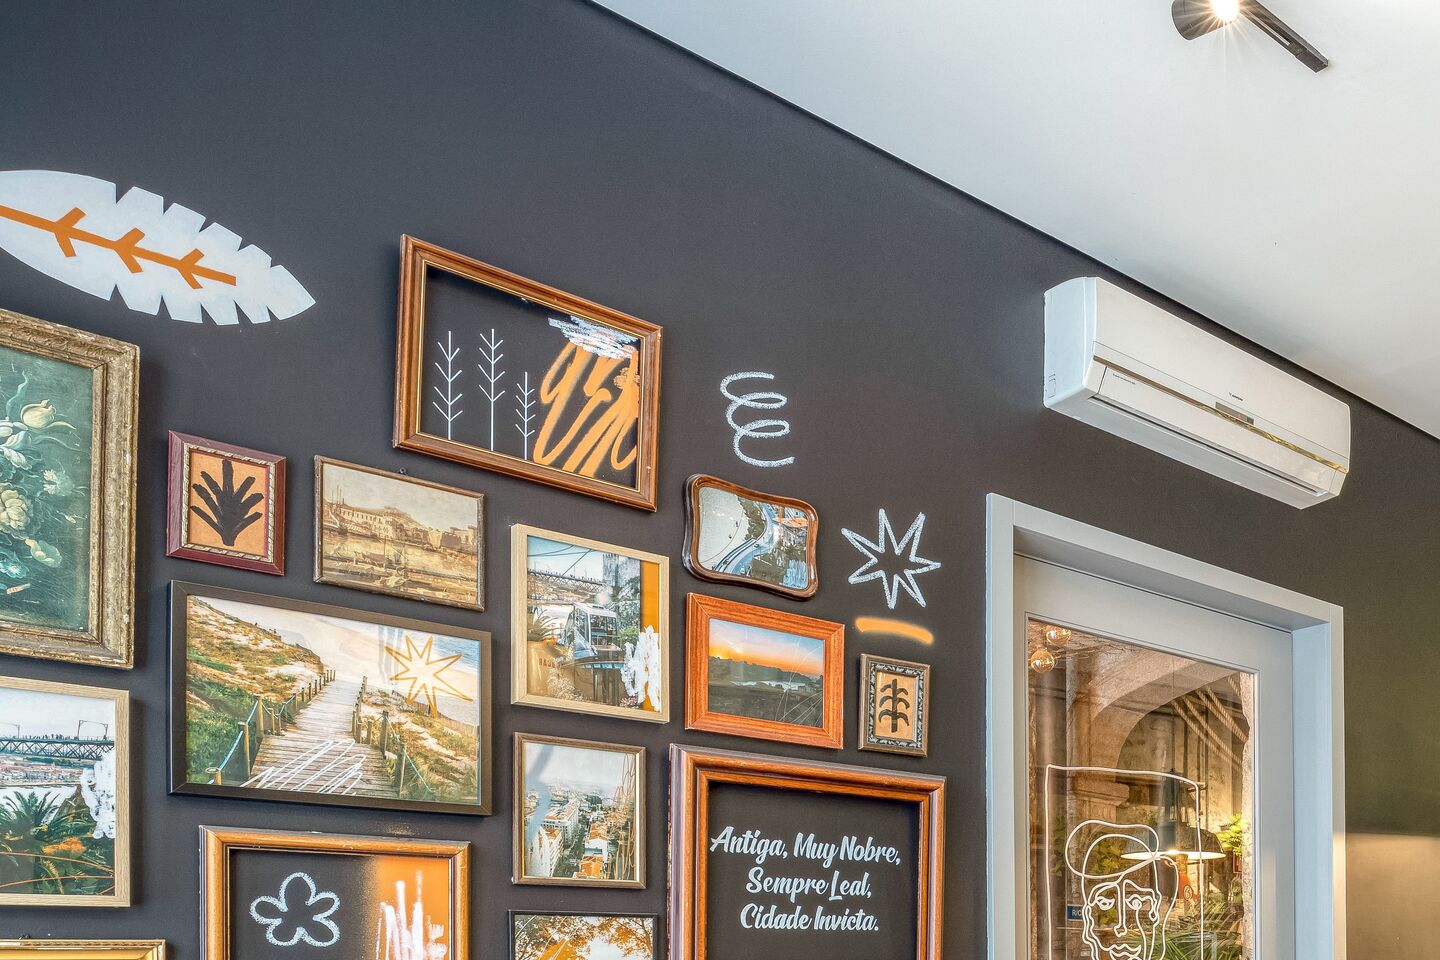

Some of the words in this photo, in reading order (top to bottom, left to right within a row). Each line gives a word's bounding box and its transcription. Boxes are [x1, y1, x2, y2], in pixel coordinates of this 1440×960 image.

[709, 826, 788, 865] Antiga,
[793, 831, 840, 868] Muy
[839, 835, 901, 866] Nobre,
[745, 867, 830, 904] Sempre
[829, 870, 872, 902] Leal,
[739, 902, 813, 930] Cidade
[813, 905, 879, 932] Invicta.
